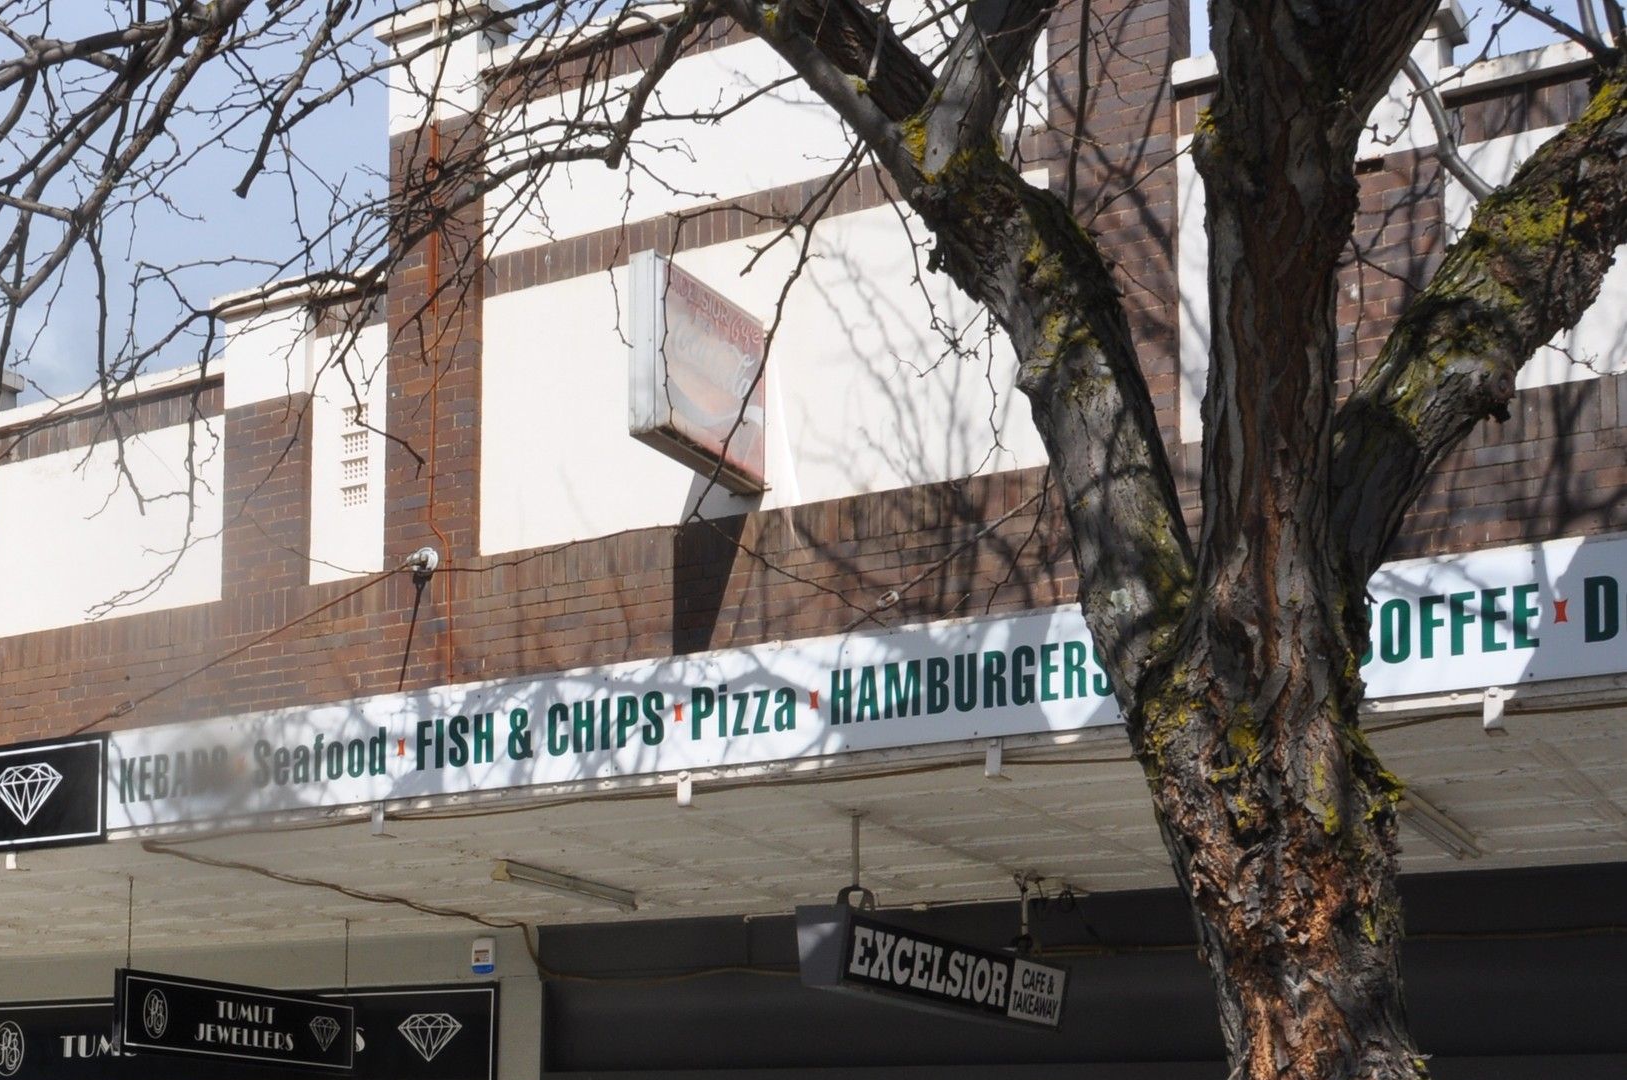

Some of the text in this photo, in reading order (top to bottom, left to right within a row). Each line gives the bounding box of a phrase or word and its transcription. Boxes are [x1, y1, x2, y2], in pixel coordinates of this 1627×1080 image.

[1360, 575, 1627, 666] OFFEE D
[254, 726, 387, 789] Seafood
[416, 711, 494, 770] FISH
[509, 708, 534, 759] &
[548, 690, 665, 757] CHIPS
[691, 684, 796, 741] Pizza
[831, 641, 1114, 725] HAMBURGERS
[849, 925, 1008, 1007] EXCELSIOR
[1023, 968, 1055, 995] CAFE &
[216, 1000, 275, 1024] TUMUT
[1012, 991, 1058, 1019] TAKEAWAY
[60, 1034, 138, 1058] TUM
[194, 1023, 294, 1051] JEWELLERS
